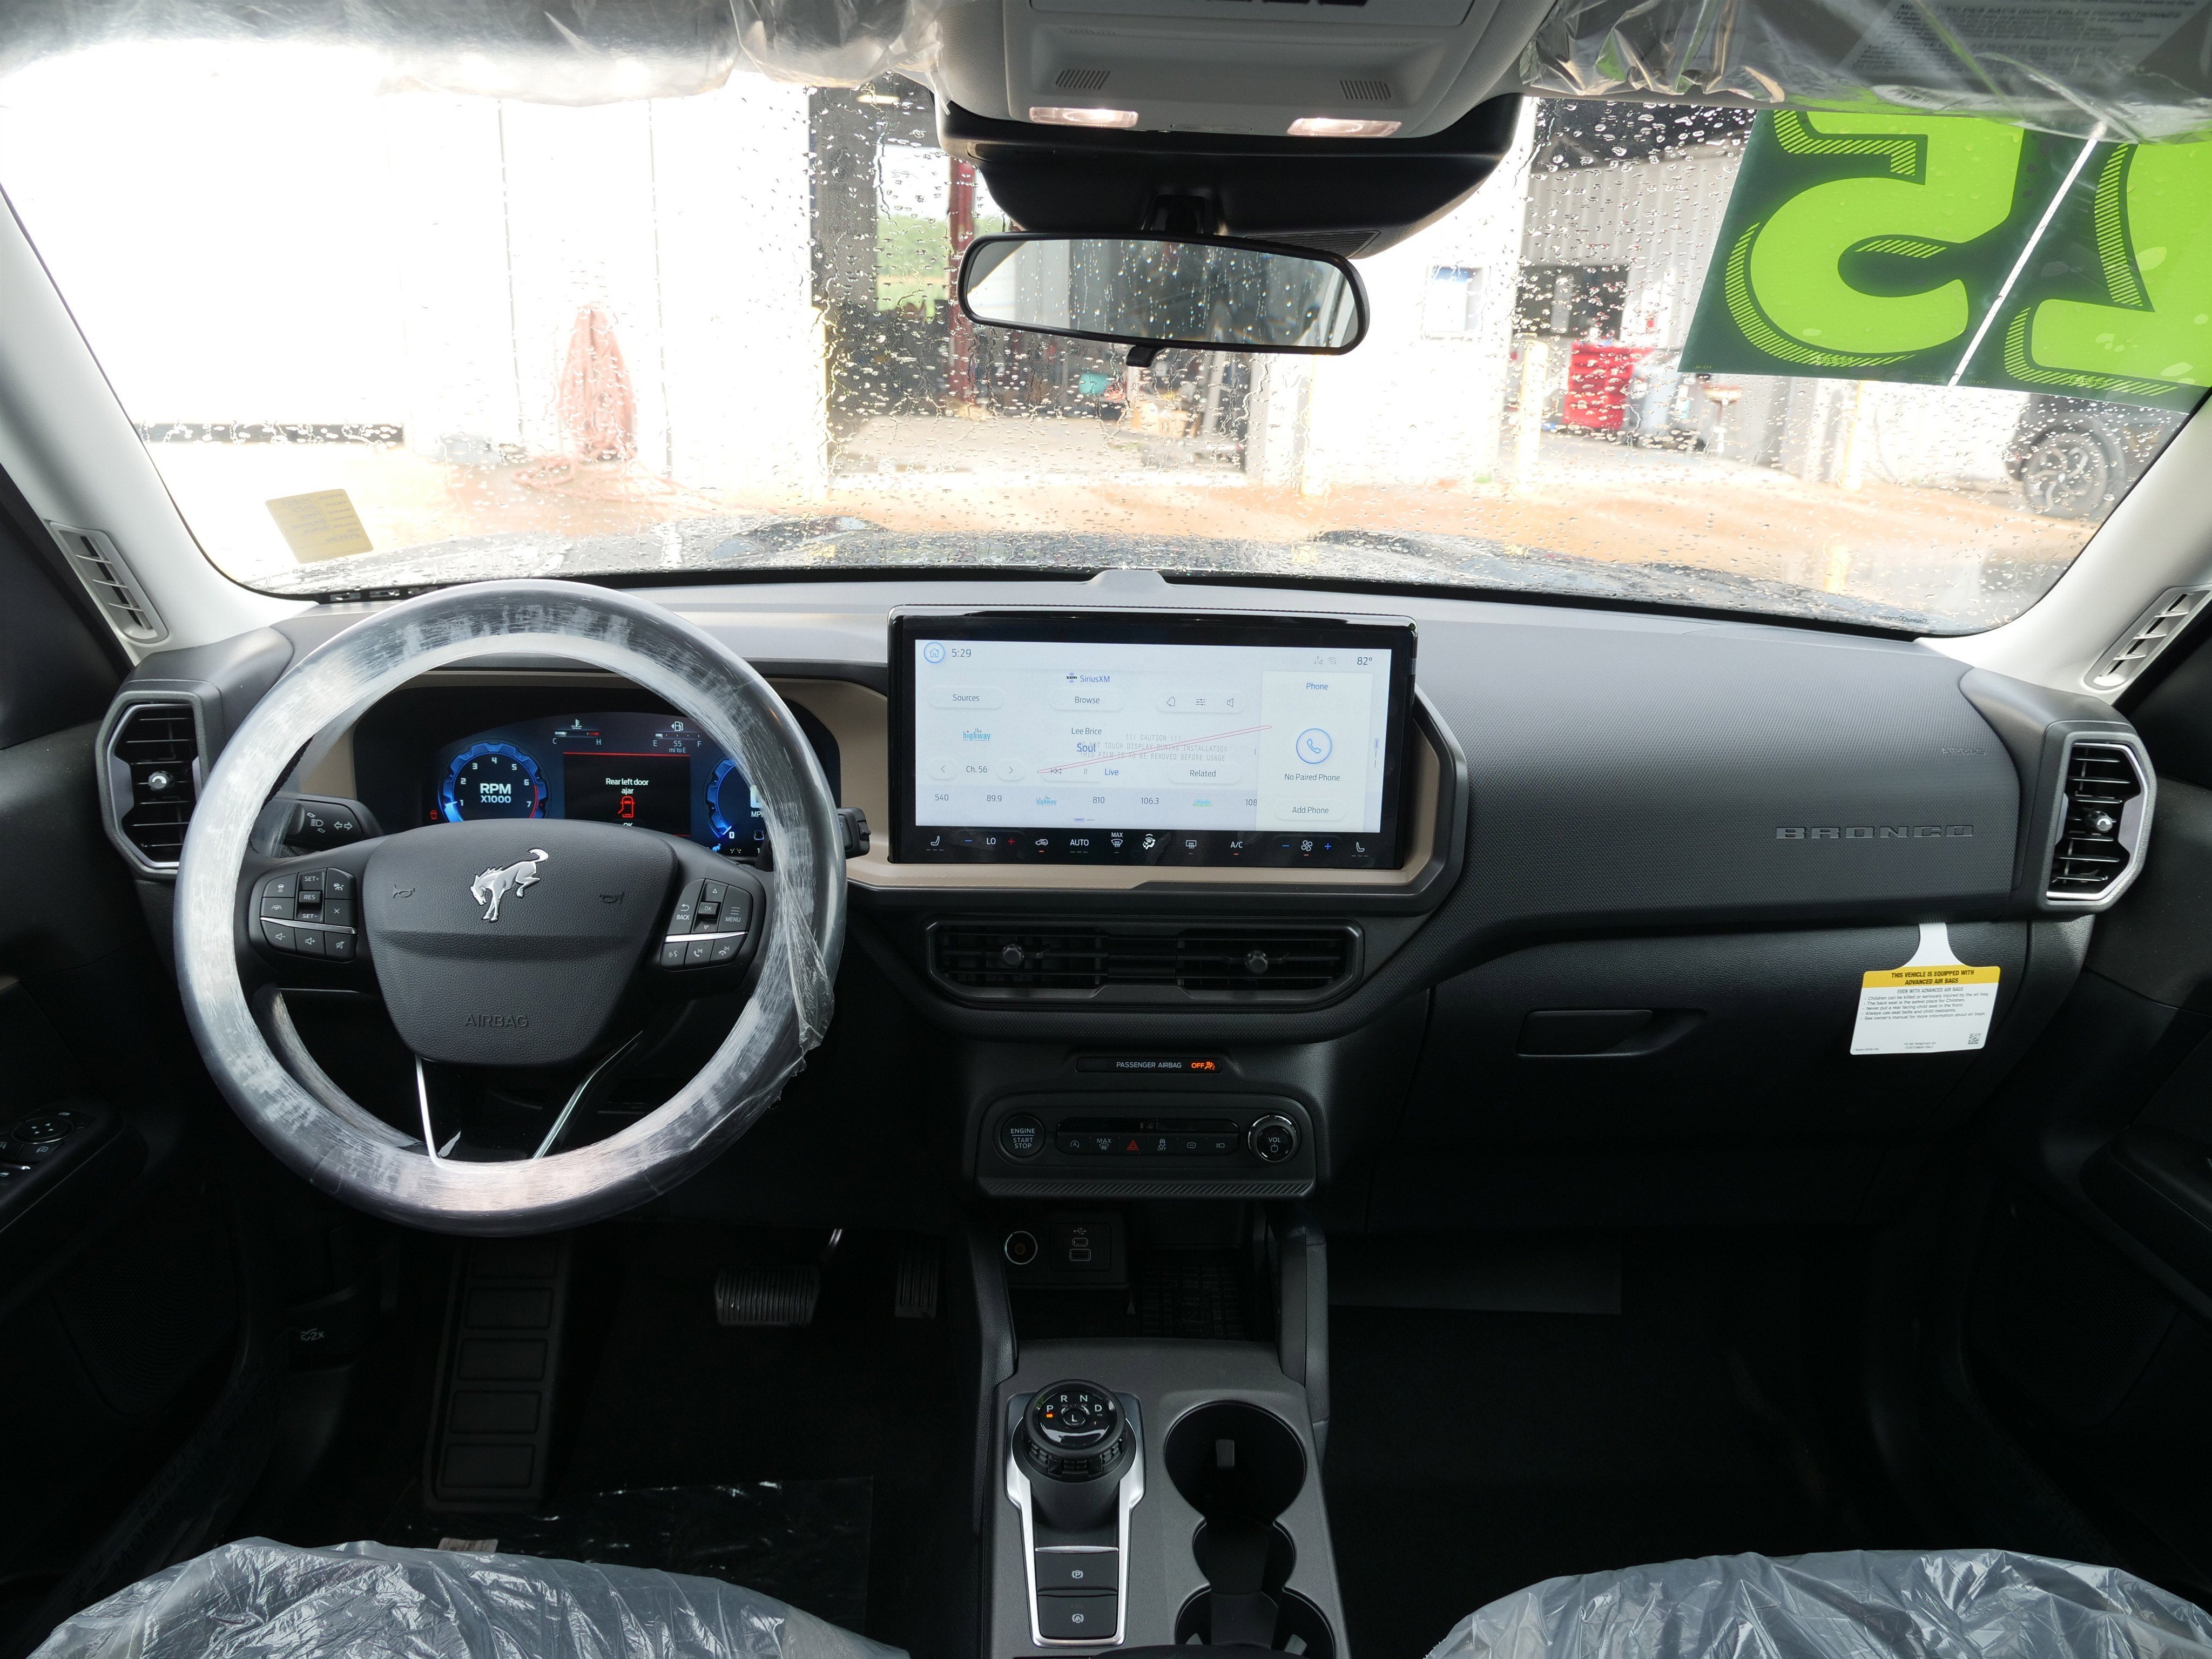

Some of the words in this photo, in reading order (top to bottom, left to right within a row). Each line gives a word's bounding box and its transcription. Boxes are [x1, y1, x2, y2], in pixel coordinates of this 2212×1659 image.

[952, 649, 972, 658] 5:29
[1357, 657, 1373, 665] 82°
[963, 730, 990, 740] highway
[1076, 743, 1096, 752] Soul
[480, 783, 511, 794] RPM
[1776, 825, 1974, 839] BRONCO
[465, 1014, 530, 1028] AIRBAG
[1080, 1394, 1088, 1402] N
[1095, 1404, 1103, 1412] D
[1071, 1414, 1078, 1422] L
